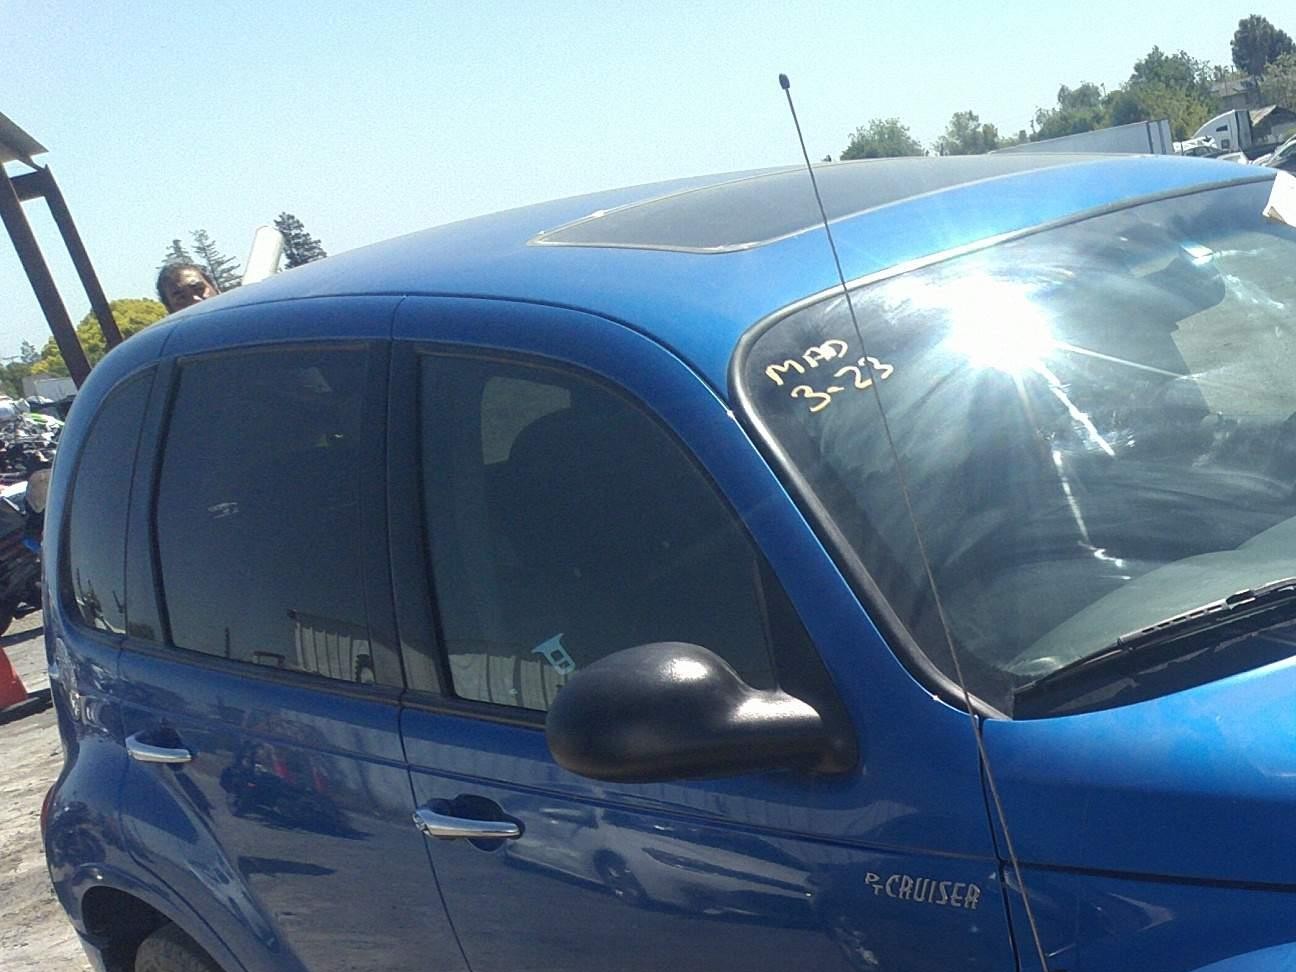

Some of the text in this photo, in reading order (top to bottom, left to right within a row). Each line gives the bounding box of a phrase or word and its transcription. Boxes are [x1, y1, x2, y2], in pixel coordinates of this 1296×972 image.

[791, 357, 894, 412] 3-23
[865, 872, 981, 909] PT CRUISER
